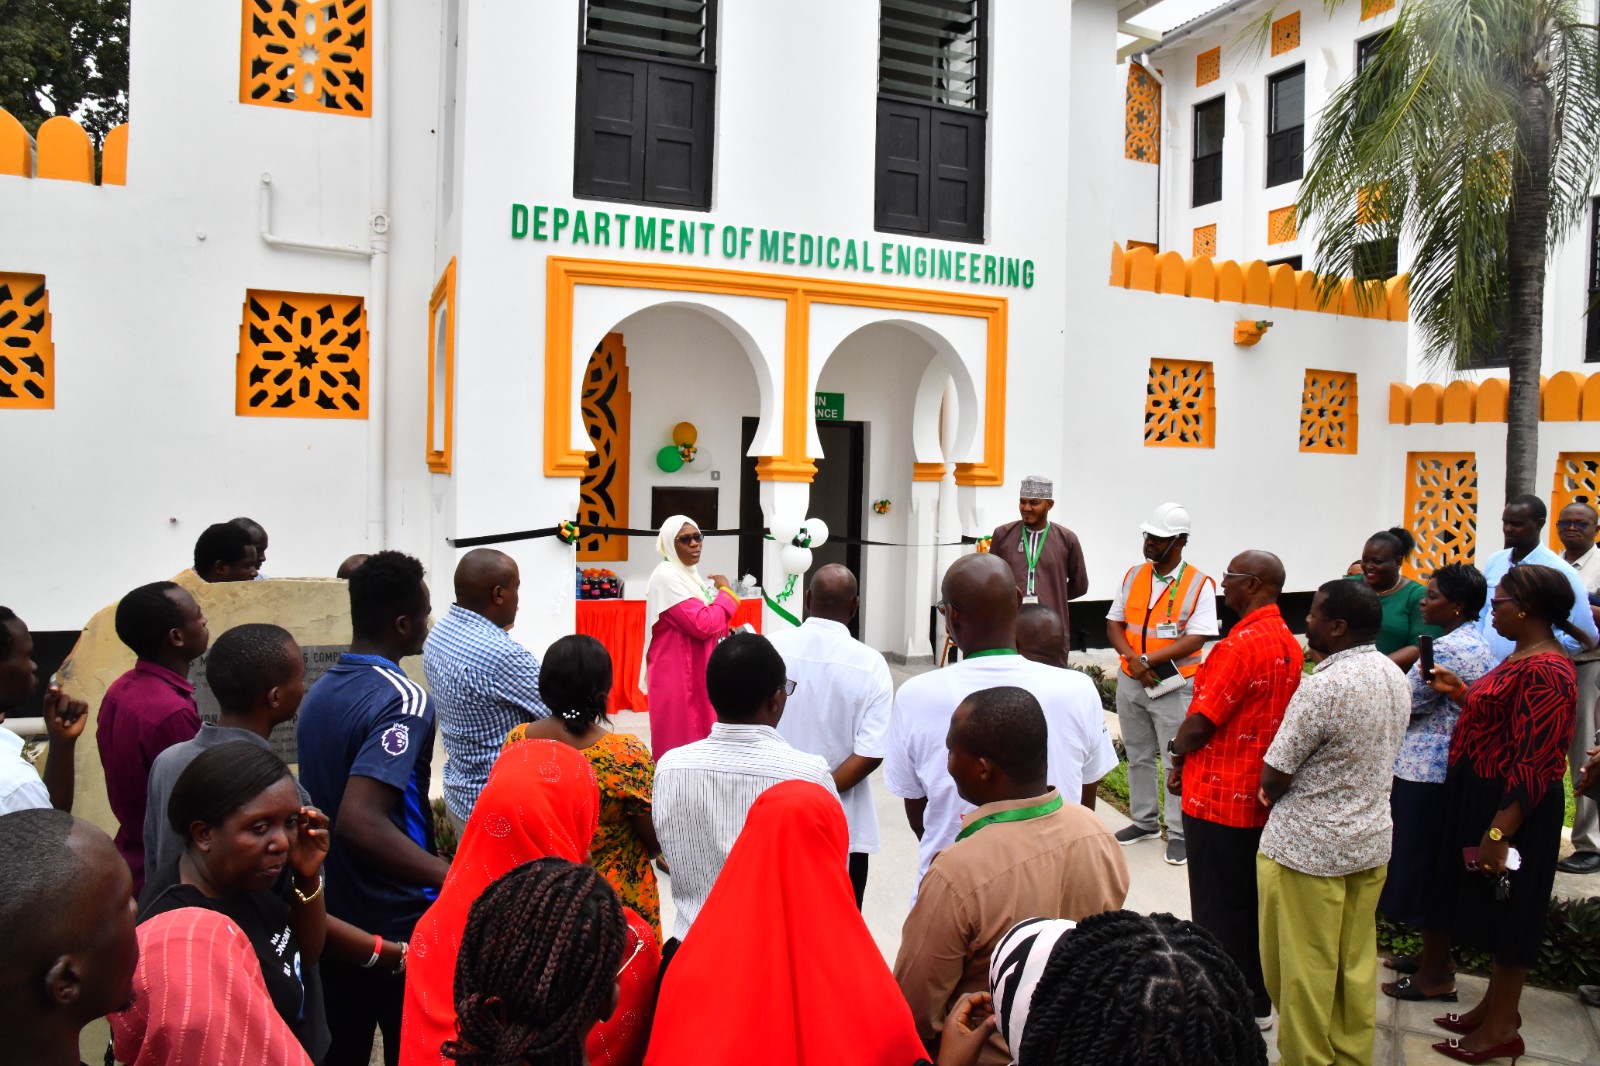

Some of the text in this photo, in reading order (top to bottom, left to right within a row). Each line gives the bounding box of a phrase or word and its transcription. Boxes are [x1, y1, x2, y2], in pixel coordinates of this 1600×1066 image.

[512, 203, 1035, 289] DEPARTMENT OF MEDICAL ENGINEERING
[816, 408, 838, 418] NCE
[313, 652, 340, 663] COMP
